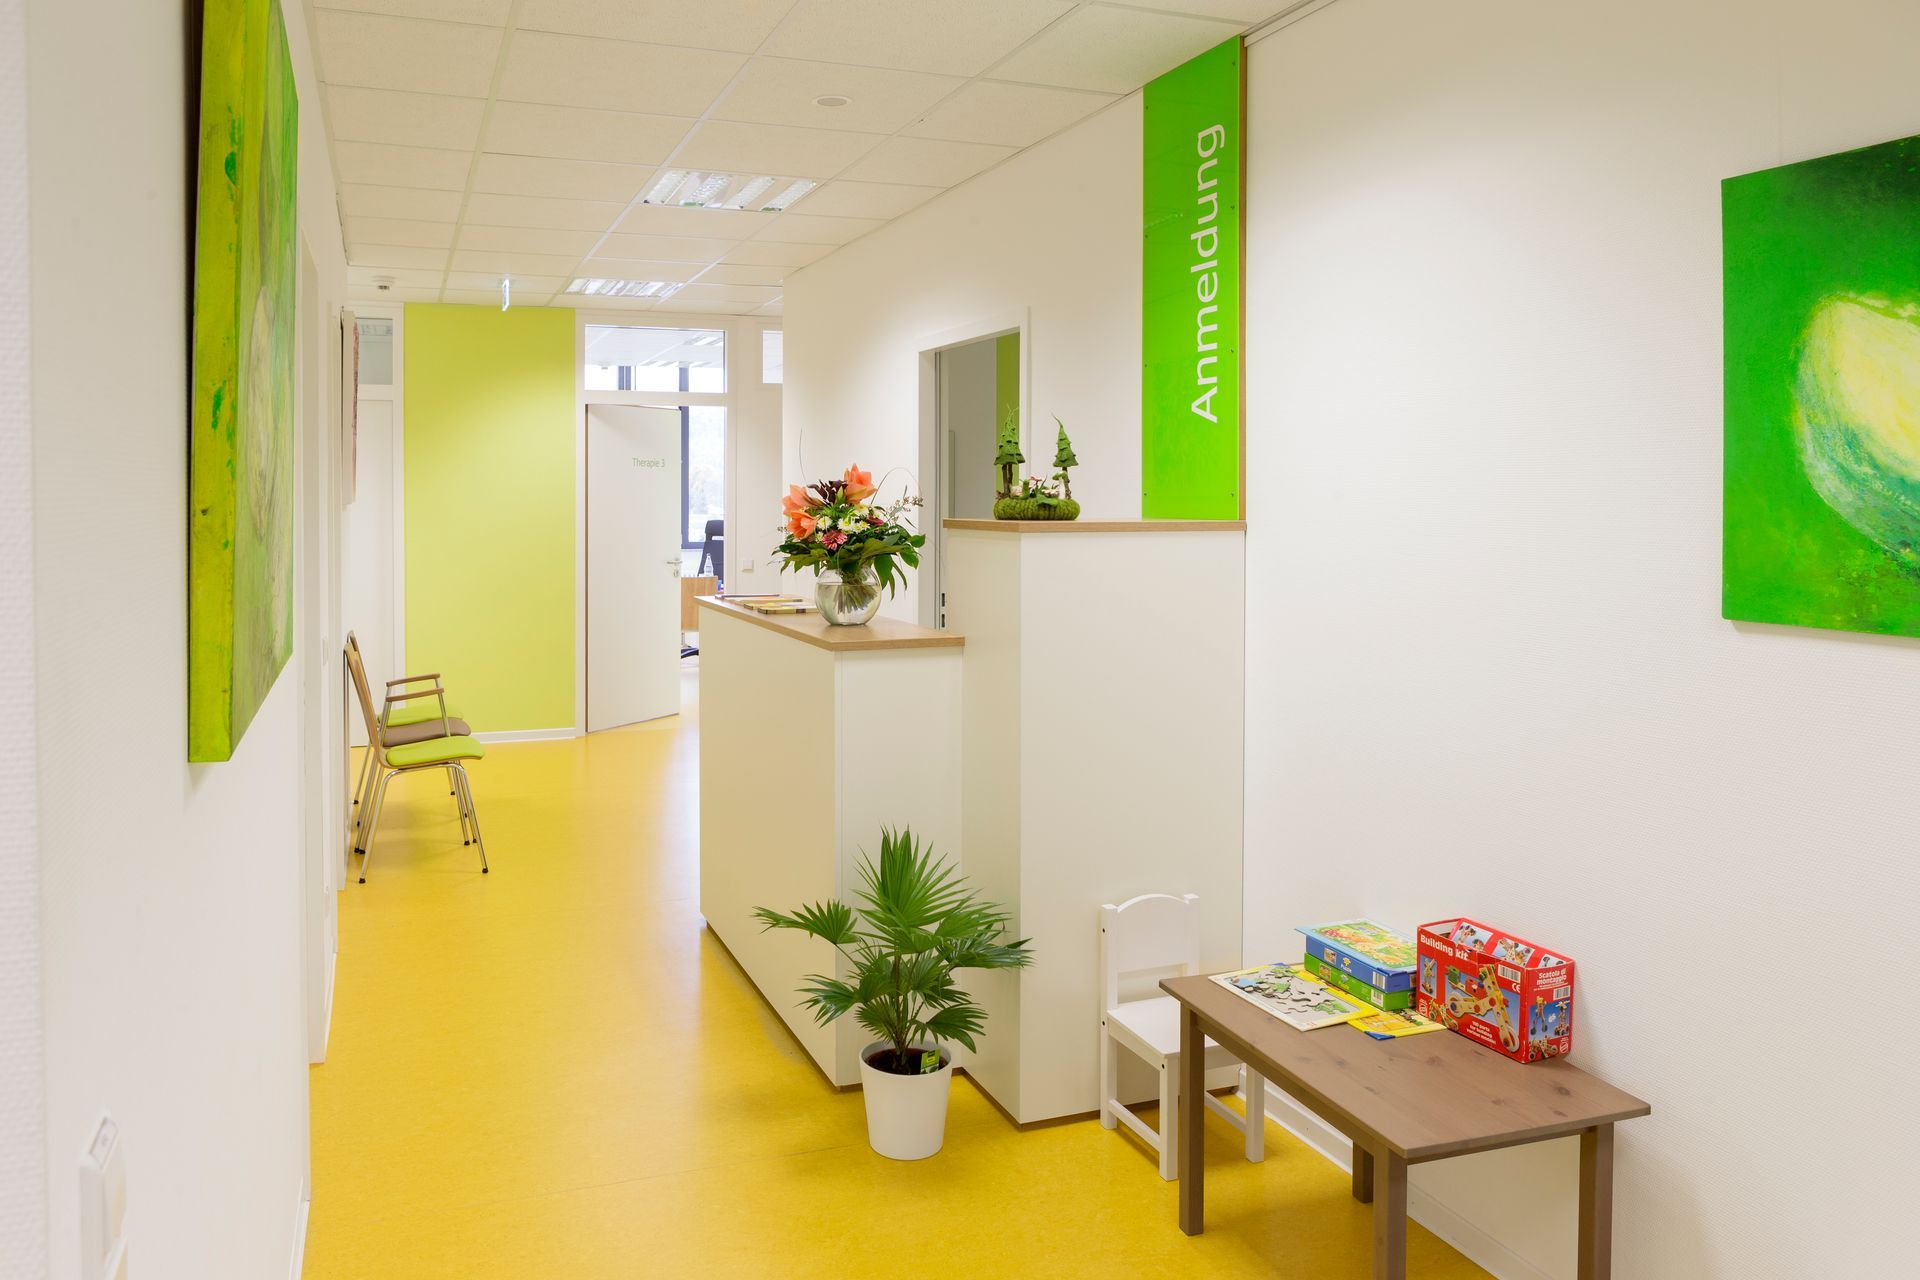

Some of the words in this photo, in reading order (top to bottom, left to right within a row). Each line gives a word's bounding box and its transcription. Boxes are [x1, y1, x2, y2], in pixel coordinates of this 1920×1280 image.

[1190, 123, 1225, 424] Anmeldung
[632, 457, 659, 469] Therapie
[660, 458, 665, 468] 3
[1420, 934, 1454, 956] Building
[1455, 948, 1469, 961] kit
